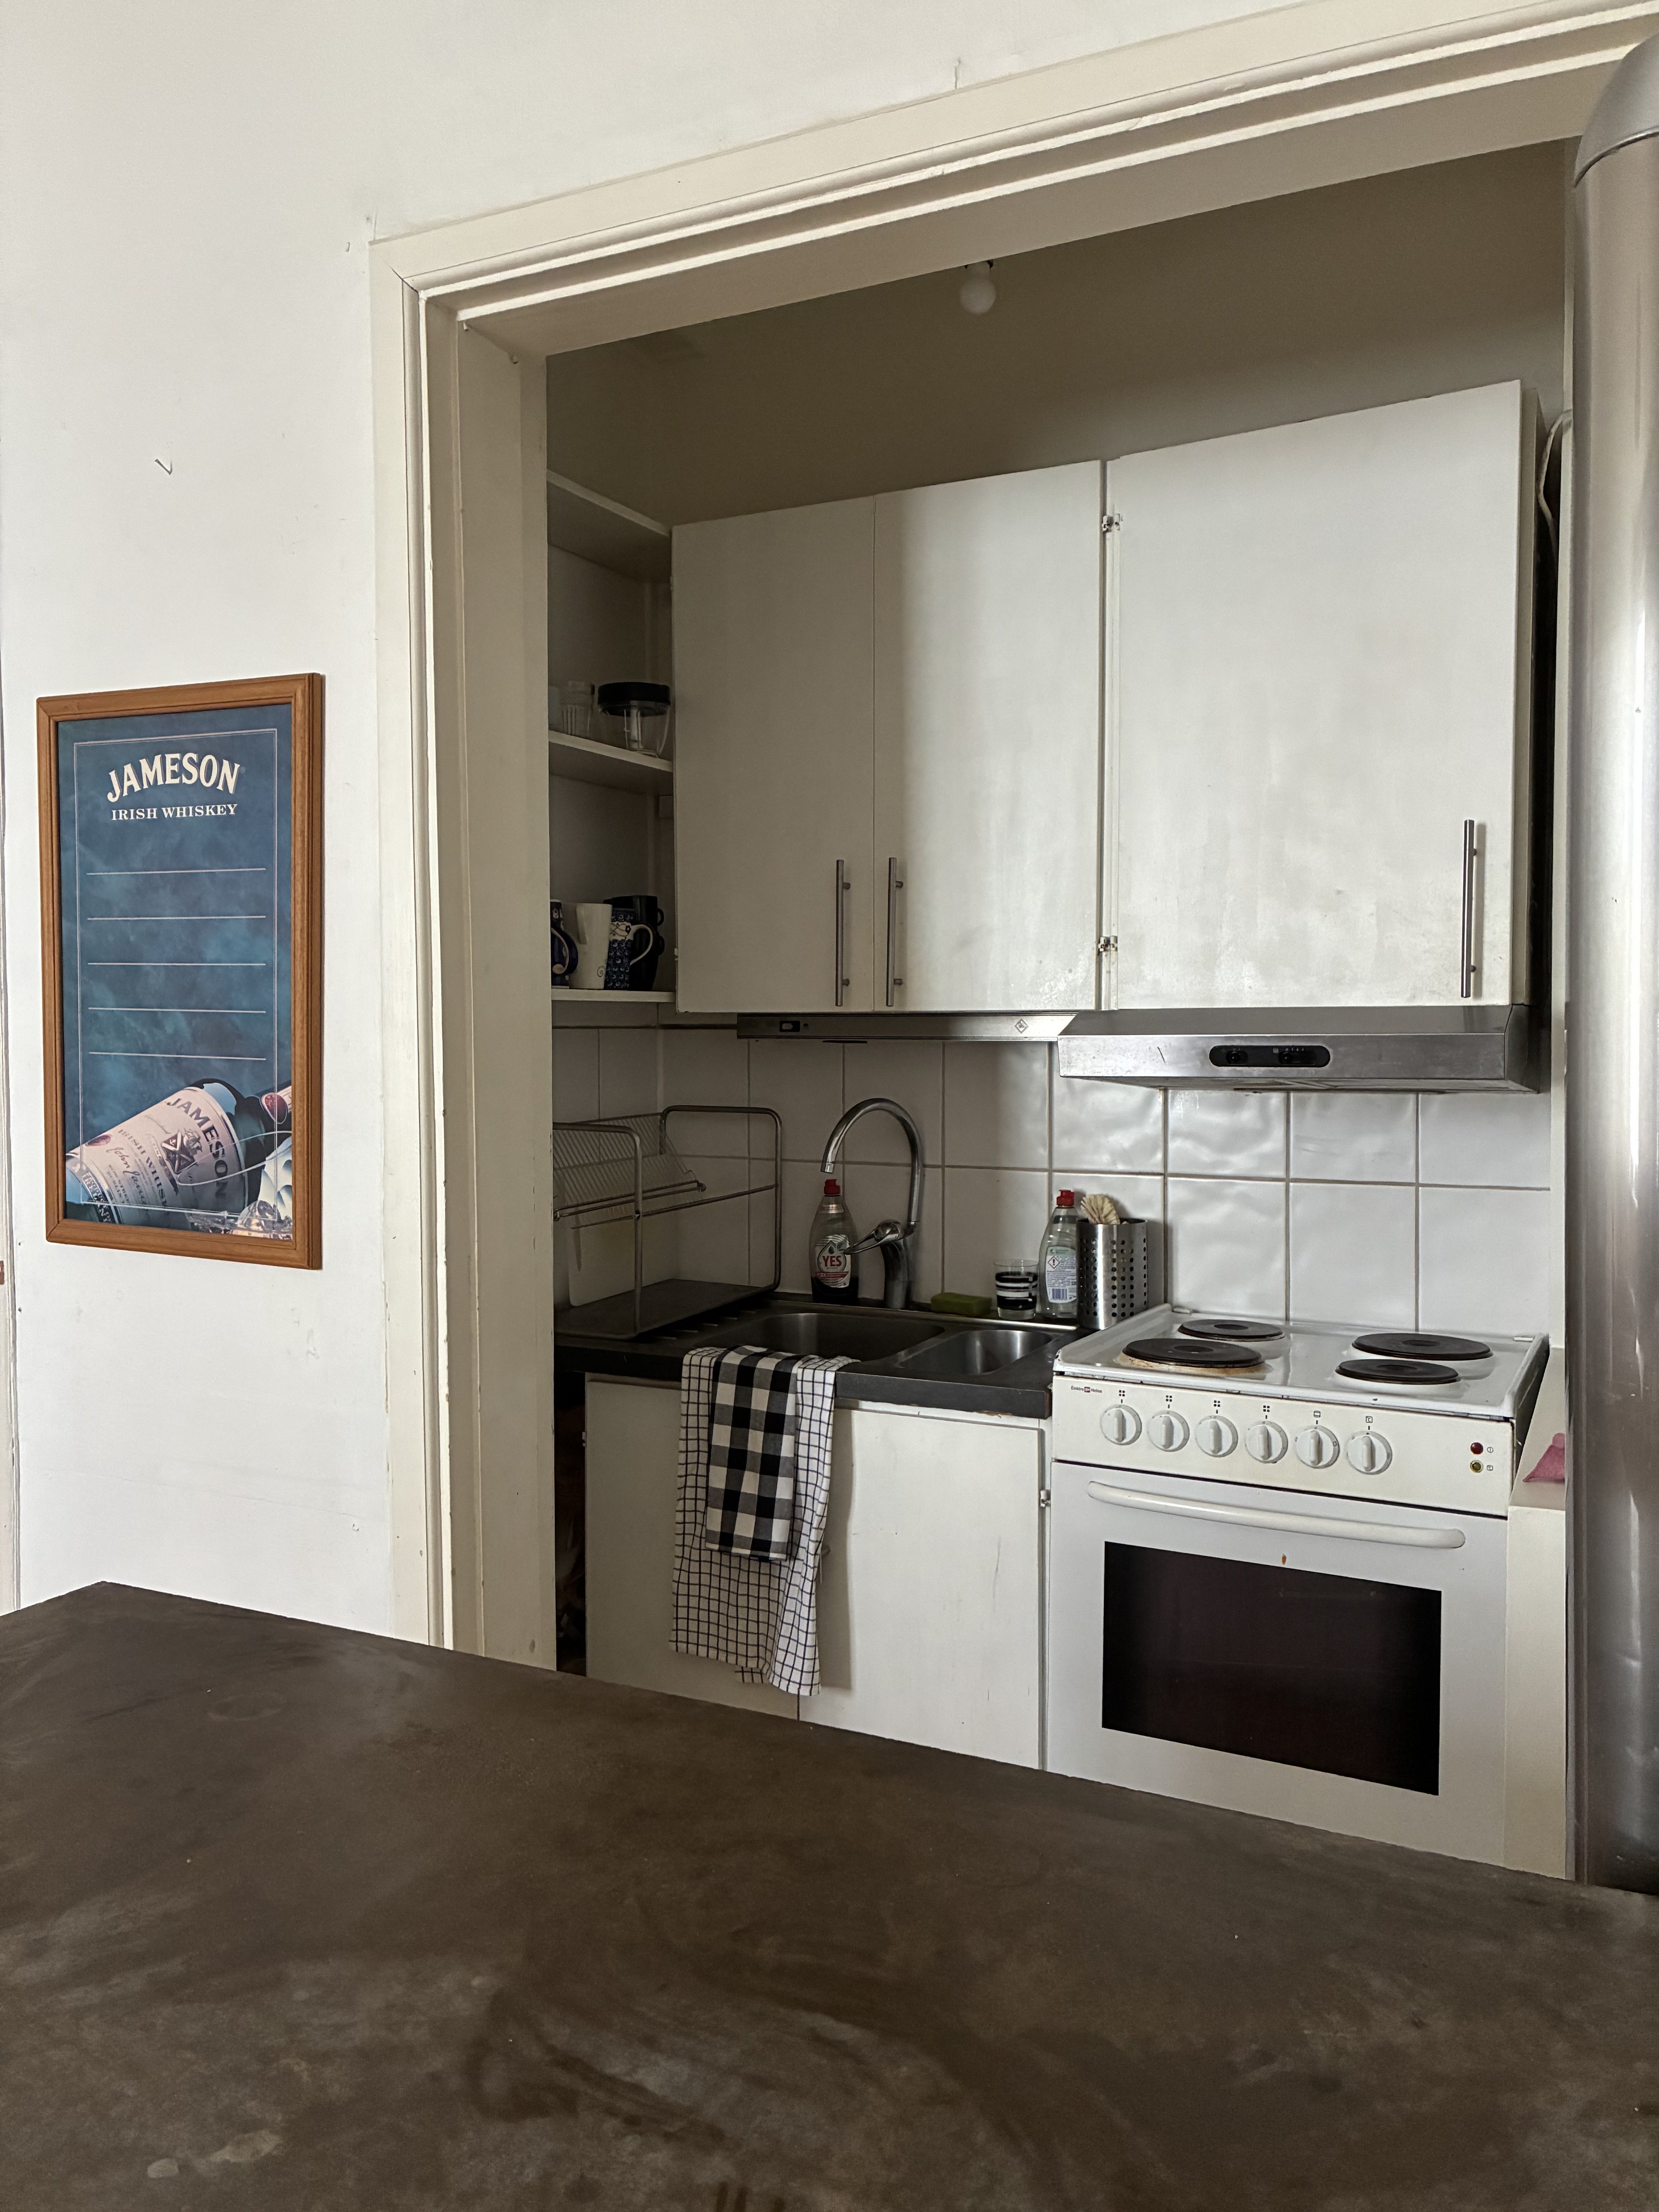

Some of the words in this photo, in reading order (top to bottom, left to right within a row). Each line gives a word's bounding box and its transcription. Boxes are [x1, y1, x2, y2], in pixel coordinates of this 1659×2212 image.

[107, 752, 240, 802] JAMESON
[111, 808, 158, 821] IRISH
[161, 804, 238, 819] WHISKEY
[118, 1129, 146, 1155] IRISH
[166, 1098, 228, 1197] JAMESON
[106, 1147, 131, 1169] John
[822, 1255, 842, 1267] YES
